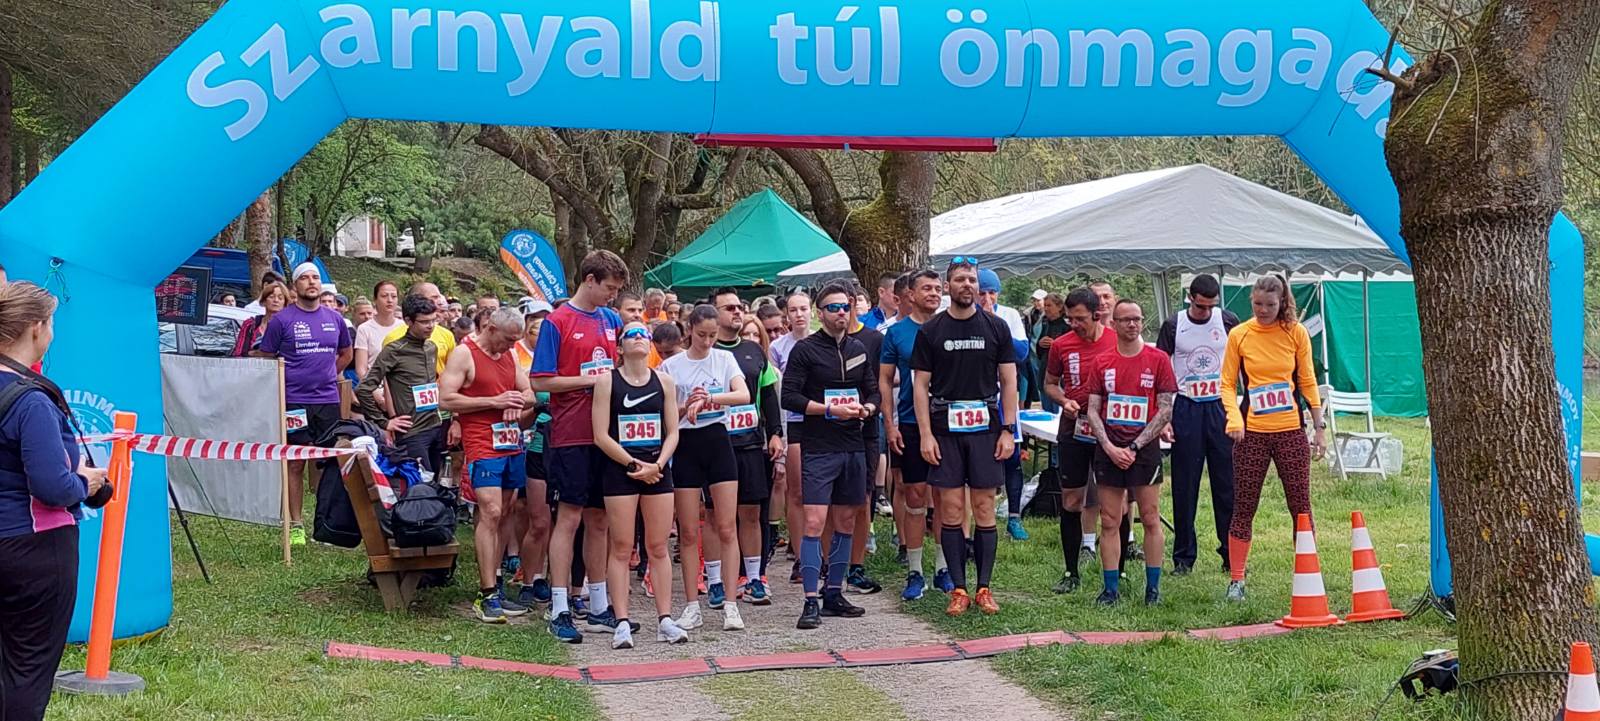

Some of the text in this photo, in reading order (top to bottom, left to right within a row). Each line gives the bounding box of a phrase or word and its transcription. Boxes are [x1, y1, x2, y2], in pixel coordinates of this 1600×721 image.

[769, 5, 900, 86] túl
[954, 340, 985, 350] SPARTAN
[418, 390, 438, 405] 531
[1191, 381, 1217, 397] 124
[1256, 390, 1288, 409] 104
[955, 410, 984, 426] 134
[1112, 403, 1142, 420] 310
[730, 412, 753, 429] 128
[625, 422, 656, 439] 345
